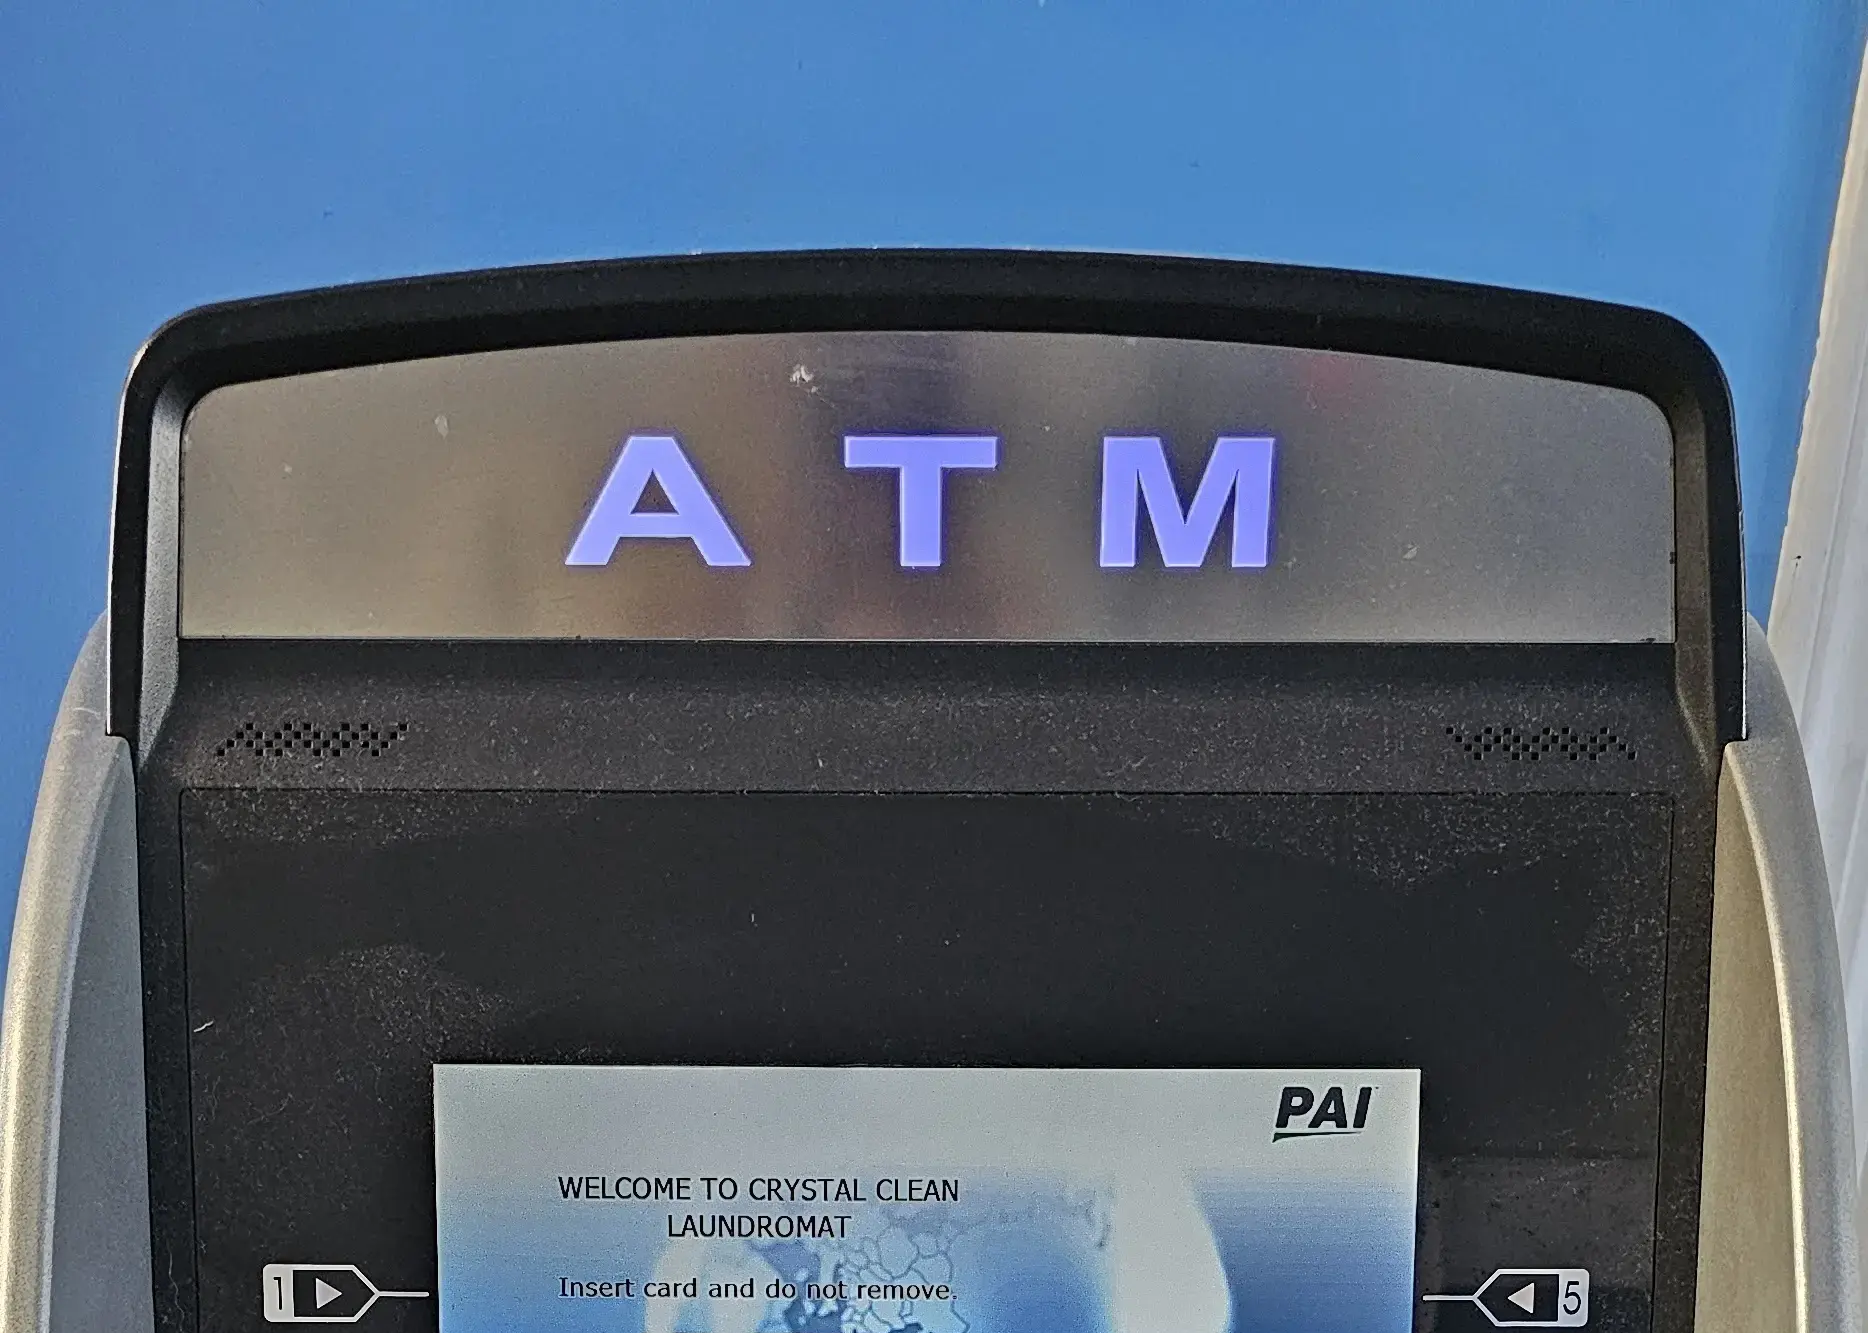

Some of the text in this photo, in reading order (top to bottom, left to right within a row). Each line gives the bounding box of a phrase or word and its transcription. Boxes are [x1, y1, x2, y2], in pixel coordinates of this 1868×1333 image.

[564, 434, 1276, 568] ATM
[1274, 1085, 1375, 1130] PAI
[558, 1176, 959, 1202] WELCOME TO CRYSTAL CLEAN
[667, 1215, 852, 1239] LAUNDROMAT
[273, 1276, 283, 1310] 1
[559, 1276, 959, 1302] Insert card and do not remove.
[1562, 1281, 1582, 1315] 5
